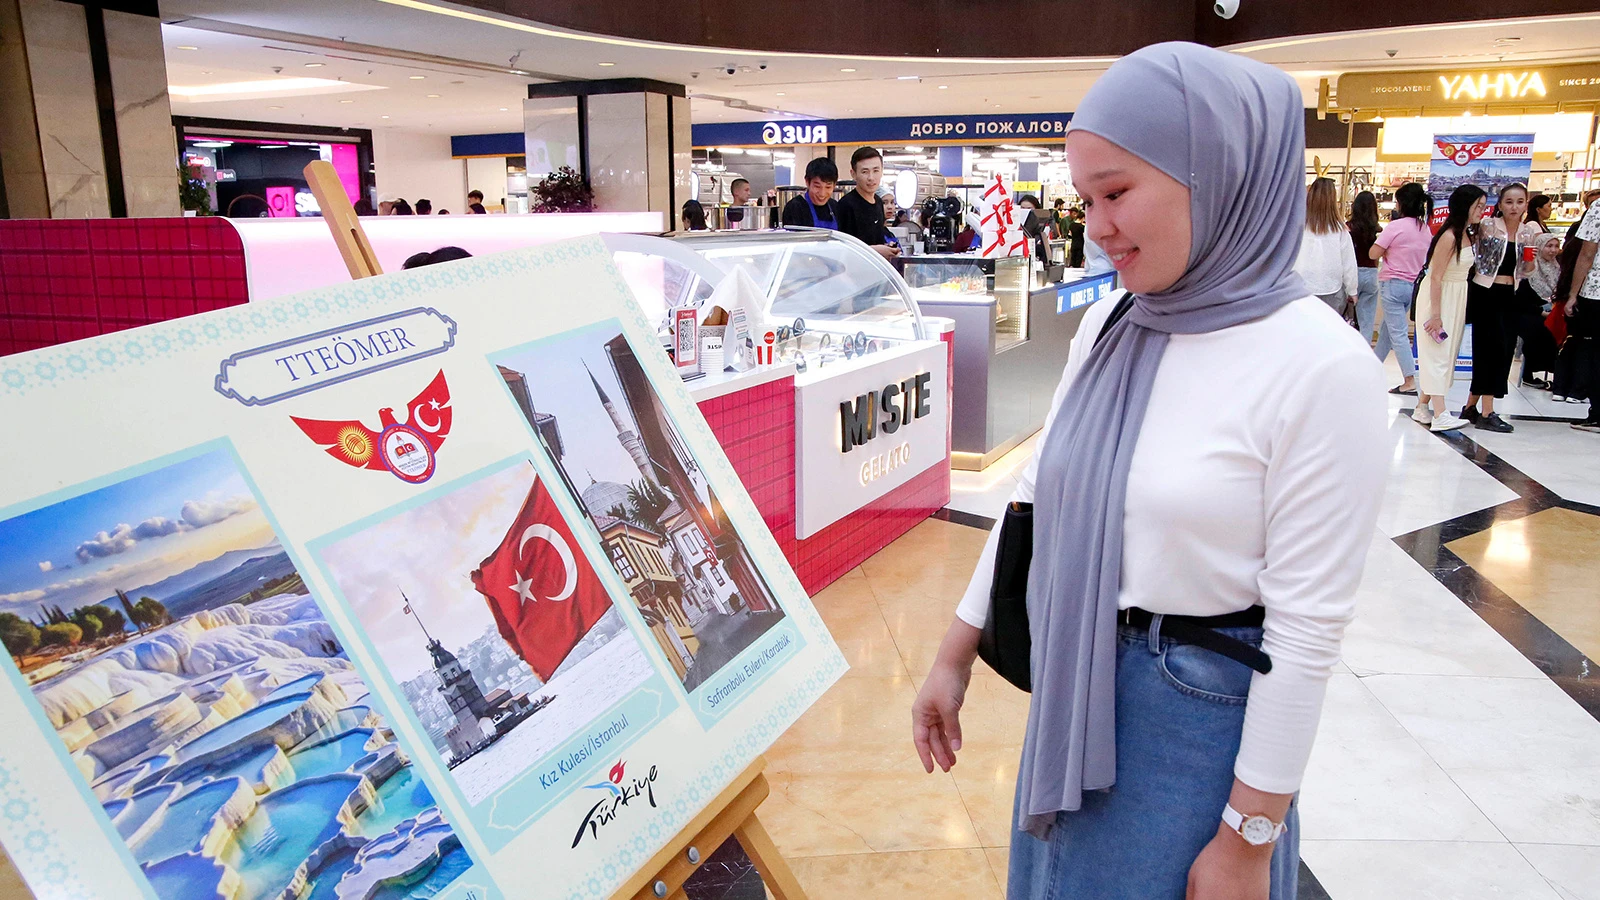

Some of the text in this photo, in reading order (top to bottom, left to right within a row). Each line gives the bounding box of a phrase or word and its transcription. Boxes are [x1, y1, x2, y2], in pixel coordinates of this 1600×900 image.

[1438, 71, 1547, 100] YAHYA
[1559, 78, 1588, 87] SINCE
[910, 122, 967, 137] ДОБРО
[1493, 145, 1529, 155] TTEÖMER
[275, 327, 416, 382] TTEÖMER
[840, 371, 931, 454] MISTE
[859, 441, 911, 487] GELATO
[706, 634, 791, 708] Safranbolu Evleri/Karabük
[538, 713, 629, 790] Kız Kulesi/İstanbul
[571, 764, 658, 849] Türkiye
